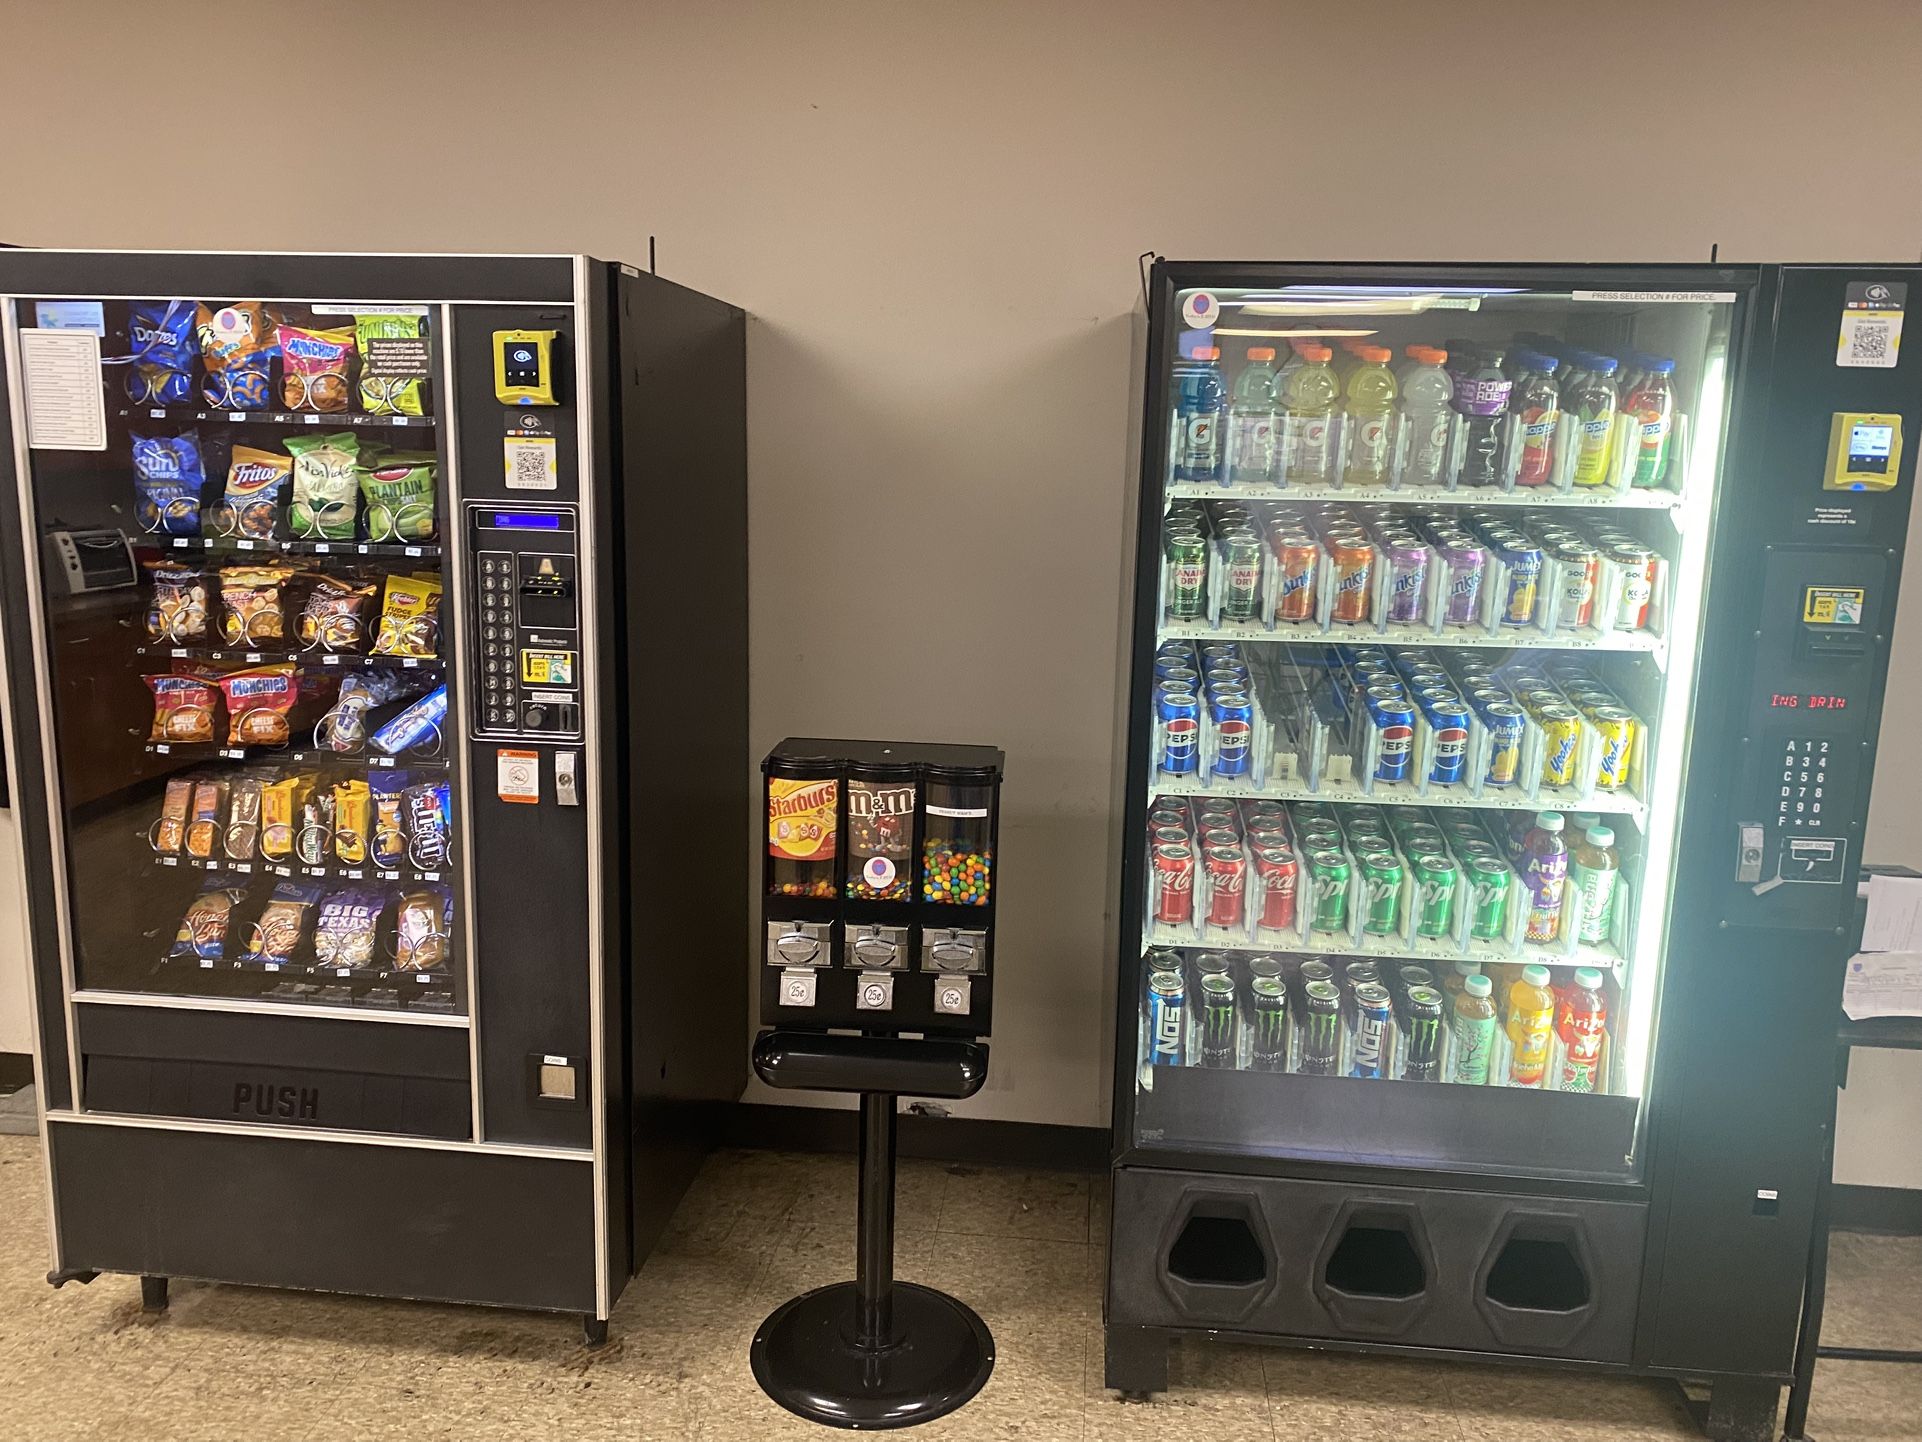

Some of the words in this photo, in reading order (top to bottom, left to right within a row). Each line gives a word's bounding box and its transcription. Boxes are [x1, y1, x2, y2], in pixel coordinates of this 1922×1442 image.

[234, 462, 278, 486] Fritos
[369, 480, 424, 499] PLANTAIN
[387, 606, 412, 615] FUDGE
[230, 677, 288, 698] MUNCHIES
[1771, 694, 1798, 708] ING
[1808, 696, 1846, 709] DRIN
[1787, 740, 1796, 752] A
[1805, 741, 1812, 752] 1
[1820, 742, 1829, 753] 2
[1785, 756, 1793, 766] B
[1802, 757, 1810, 767] 3
[1818, 757, 1826, 768] 4
[1783, 771, 1792, 782] C
[1800, 772, 1808, 783] 5
[1816, 772, 1825, 783] 6
[1781, 786, 1790, 797] D
[1798, 787, 1806, 798] 7
[1814, 787, 1822, 798] 8
[1780, 802, 1787, 812] E
[1796, 802, 1804, 813] 9
[1778, 816, 1786, 826] F
[323, 904, 369, 917] BIG
[317, 915, 371, 929] TEXAS
[1155, 998, 1181, 1055] NOS
[1356, 1009, 1382, 1068] NOS
[232, 1082, 319, 1121] PUSH
